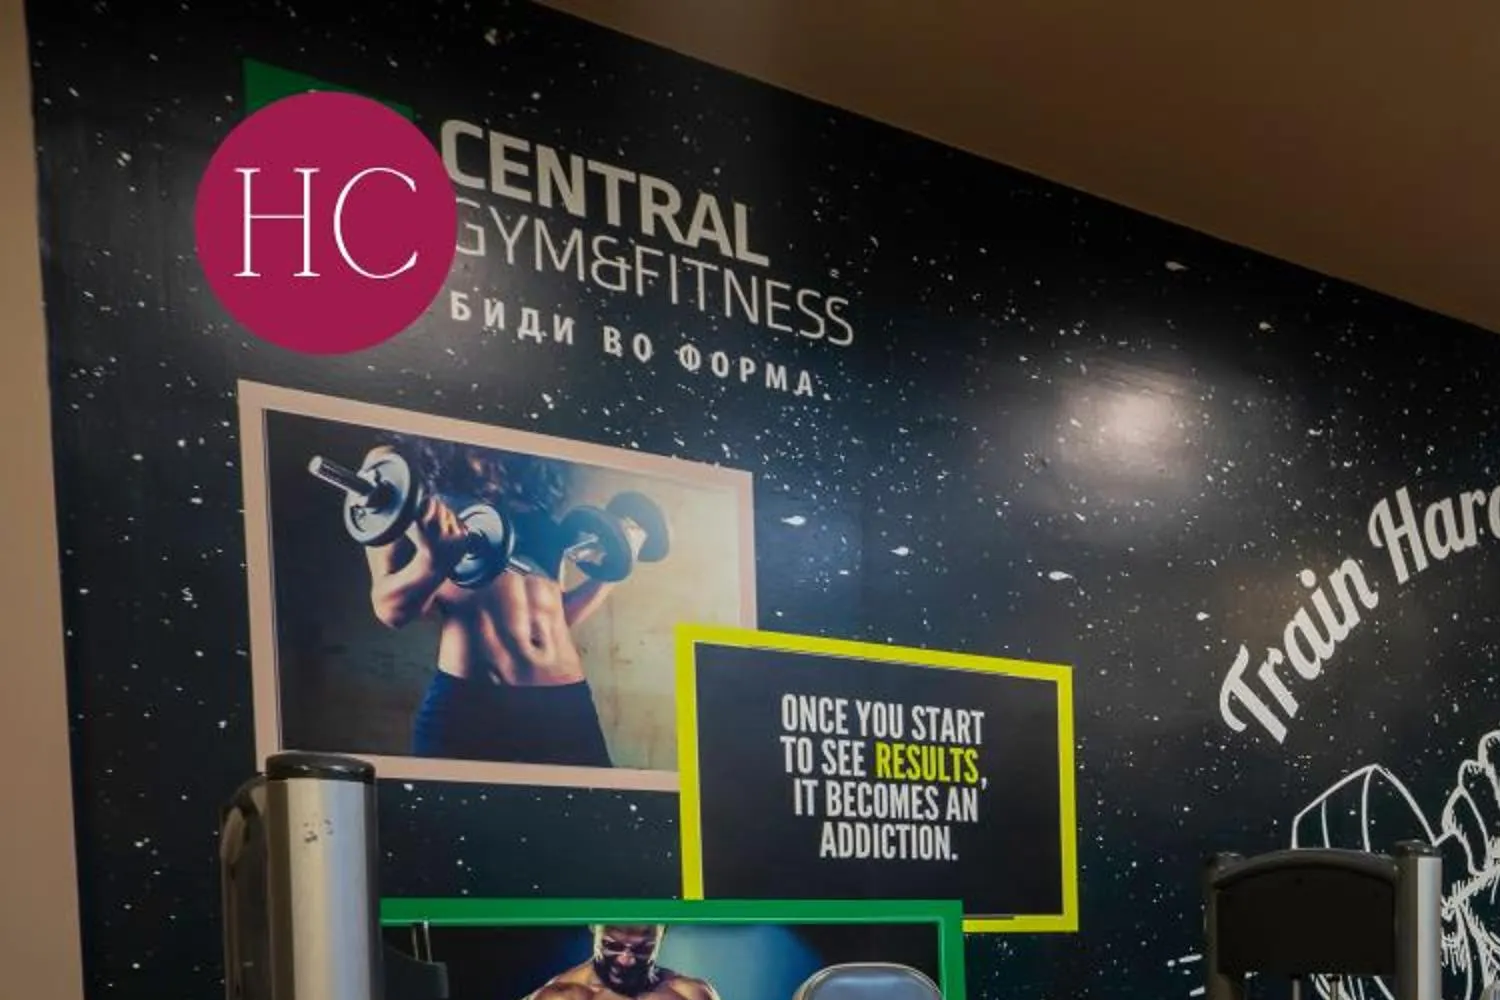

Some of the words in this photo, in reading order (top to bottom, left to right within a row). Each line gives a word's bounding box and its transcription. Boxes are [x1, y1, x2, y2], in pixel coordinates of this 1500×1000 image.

[441, 119, 769, 266] CENTRAL
[456, 196, 854, 347] GYM&FITNESS
[450, 291, 575, 346] БИДИ
[603, 329, 653, 362] ВО
[678, 343, 815, 397] ФОРМА
[1219, 556, 1378, 745] Train
[781, 694, 848, 736] ONCE
[855, 699, 903, 739] YOU
[911, 706, 985, 745] START
[780, 735, 813, 774] TO
[822, 740, 865, 777] SEE
[876, 742, 987, 790] RESULTS,
[794, 779, 818, 816] IT
[826, 781, 939, 821] BECOMES
[945, 787, 978, 823] AN
[820, 822, 959, 861] ADDICTION.
